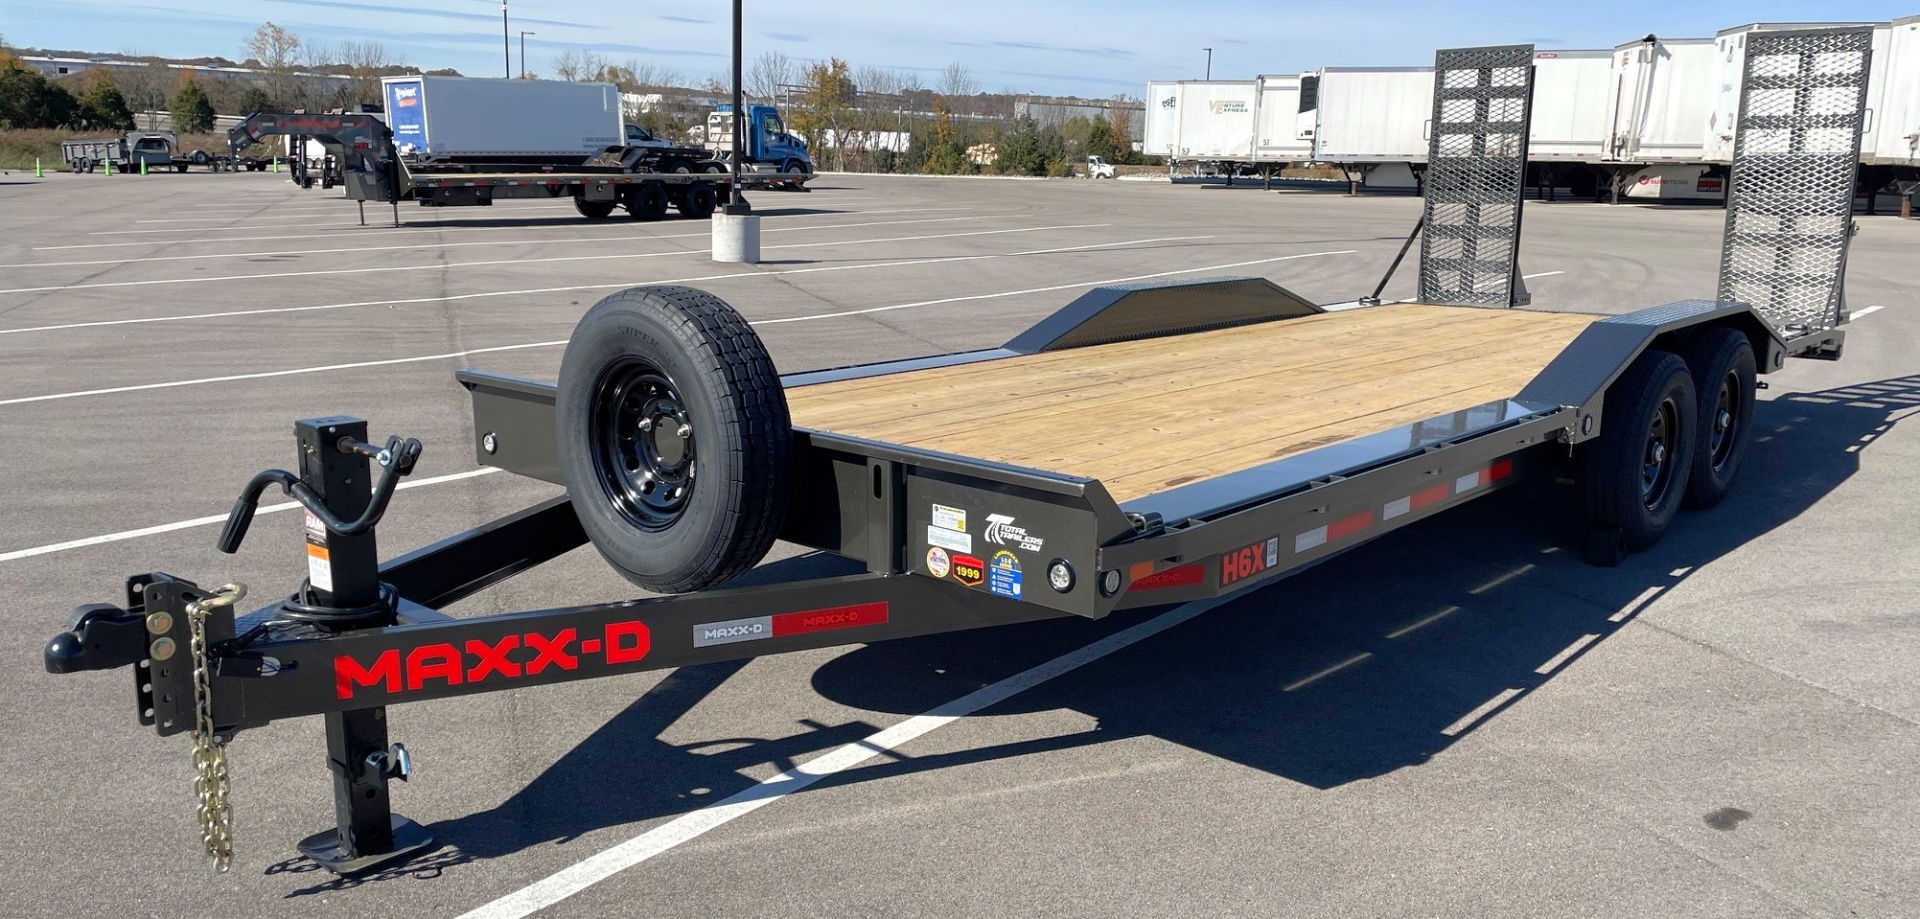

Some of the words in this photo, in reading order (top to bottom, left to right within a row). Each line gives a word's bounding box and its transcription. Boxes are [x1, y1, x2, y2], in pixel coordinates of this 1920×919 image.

[306, 514, 325, 532] RAM
[1000, 524, 1027, 536] TOTAL
[999, 532, 1044, 546] TRAILERS
[1018, 543, 1042, 553] .COM
[1222, 542, 1265, 584] H6X
[956, 566, 980, 580] 1999
[803, 611, 858, 627] MAXX-D
[704, 623, 763, 640] MAXX-D
[334, 620, 651, 700] MAXX-D
